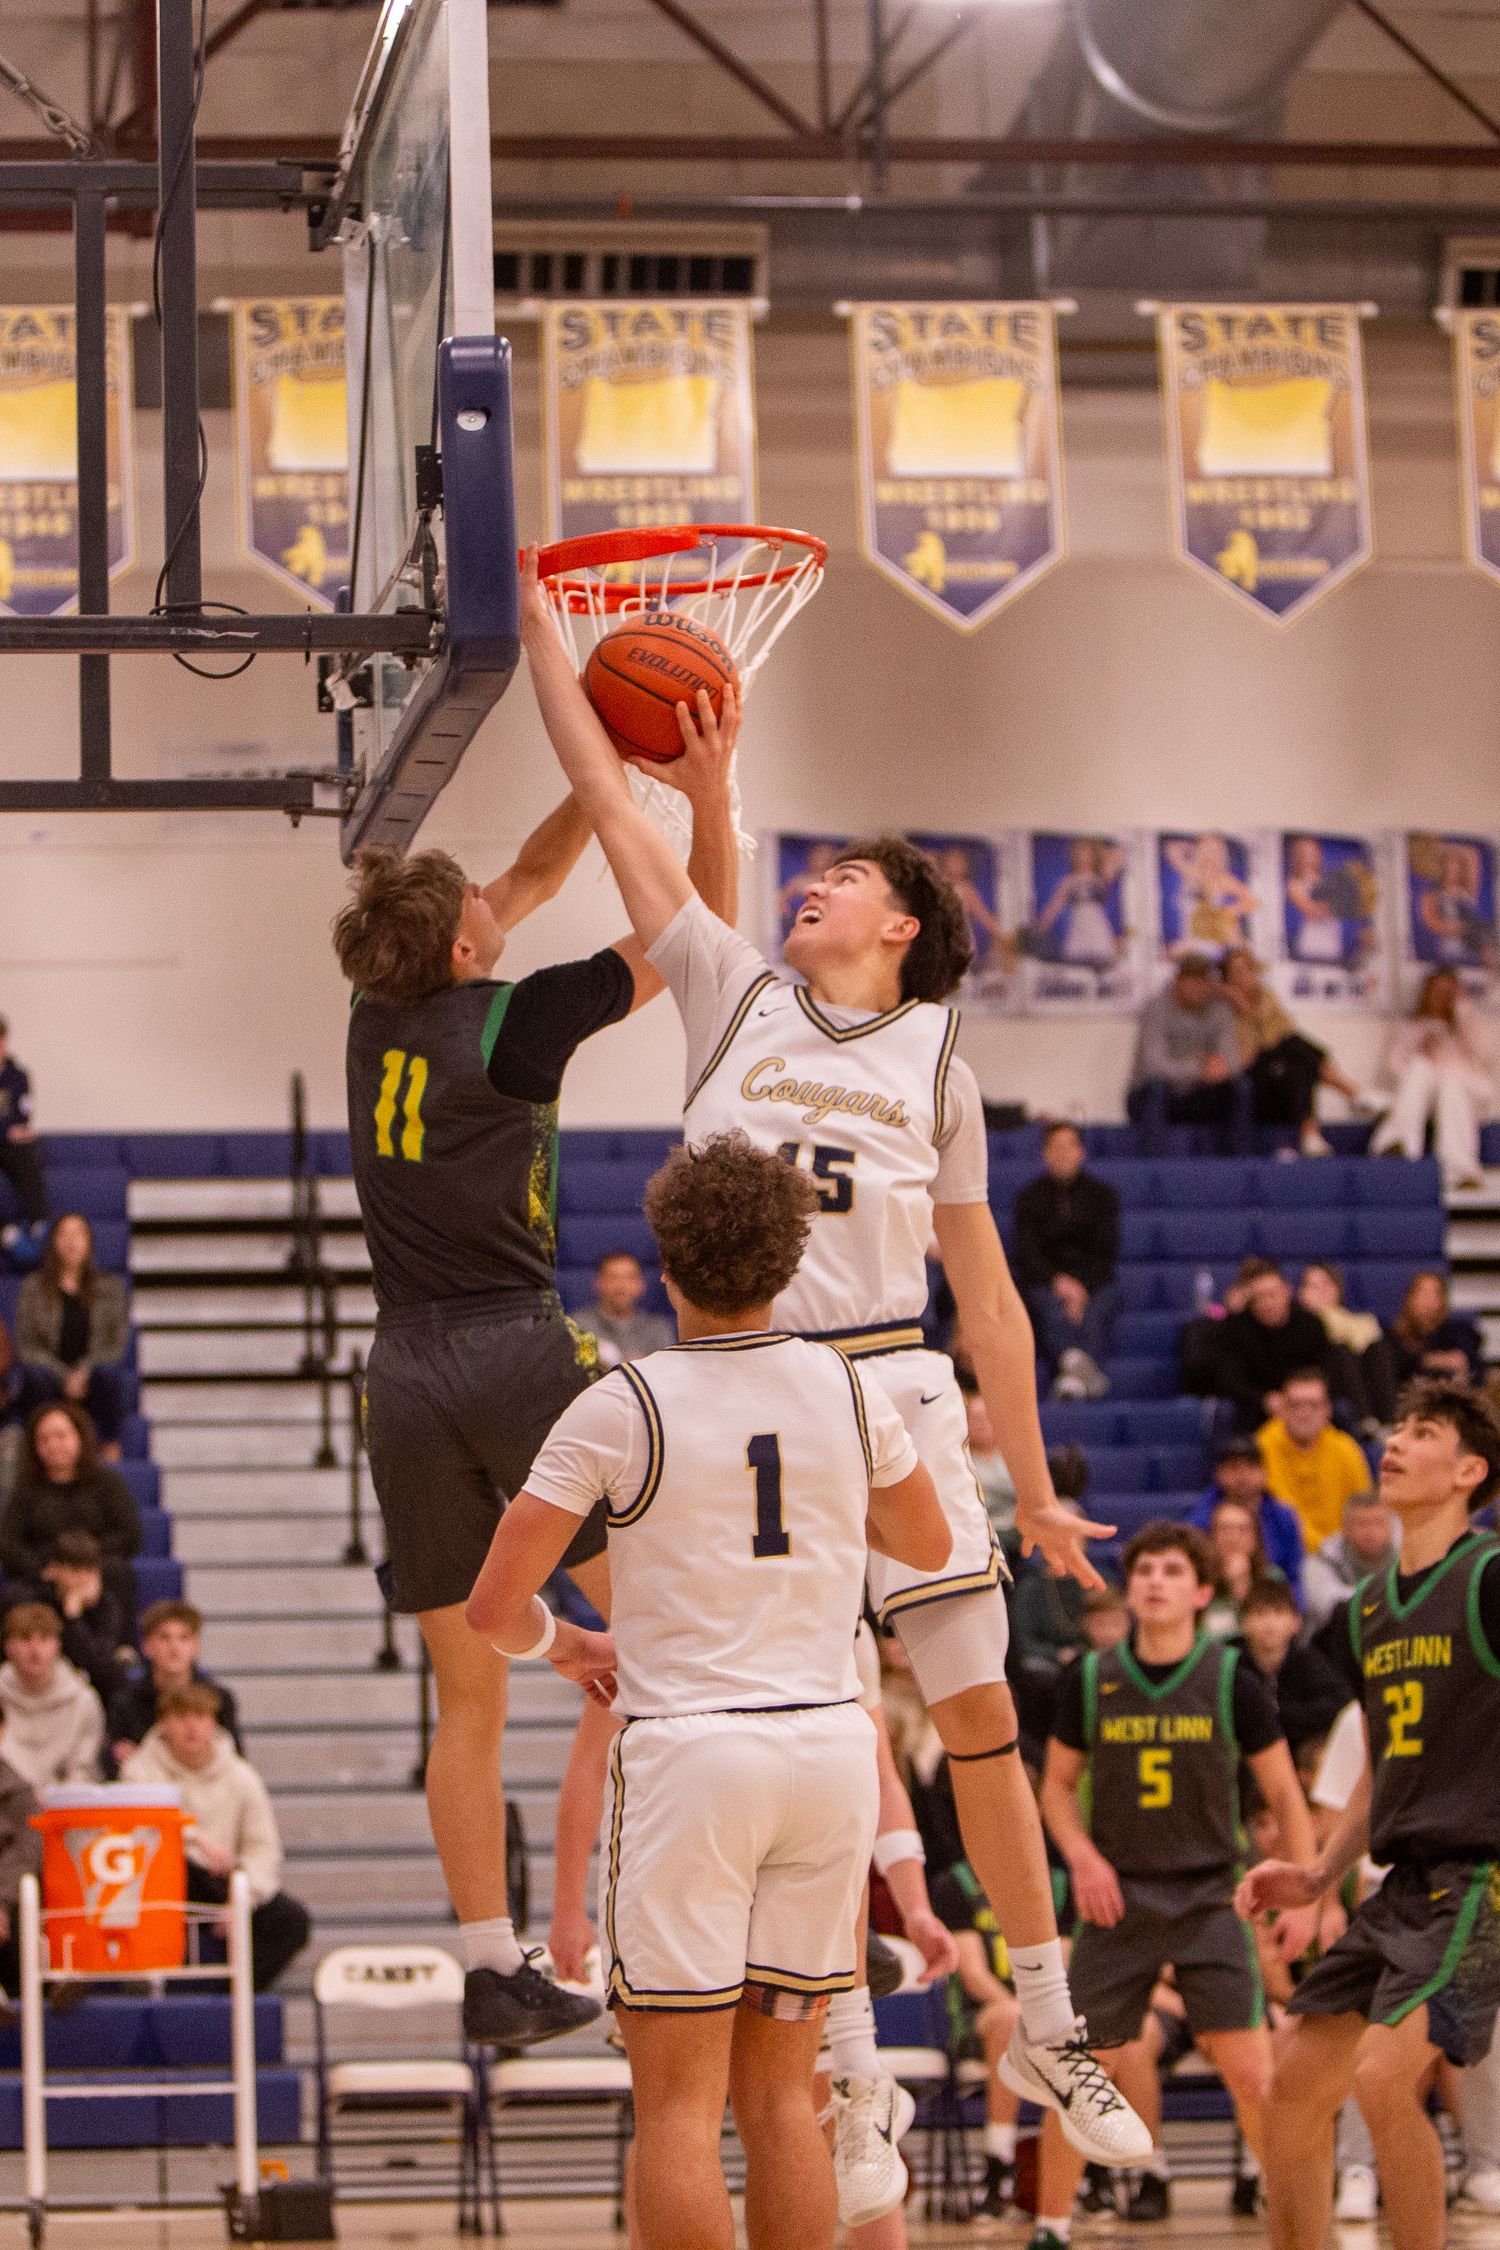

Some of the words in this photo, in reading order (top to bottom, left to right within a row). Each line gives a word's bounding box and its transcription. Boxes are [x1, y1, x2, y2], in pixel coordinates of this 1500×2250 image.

[559, 308, 737, 351] STATE
[871, 308, 1042, 352] STATE
[1179, 310, 1347, 353] STATE
[374, 1049, 428, 1163] 11
[741, 1056, 911, 1128] Cougars
[744, 1431, 793, 1561] 1
[1102, 1715, 1158, 1742] WEST
[1161, 1715, 1213, 1742] LINN
[1138, 1749, 1172, 1809] 5
[90, 1833, 135, 1885] G
